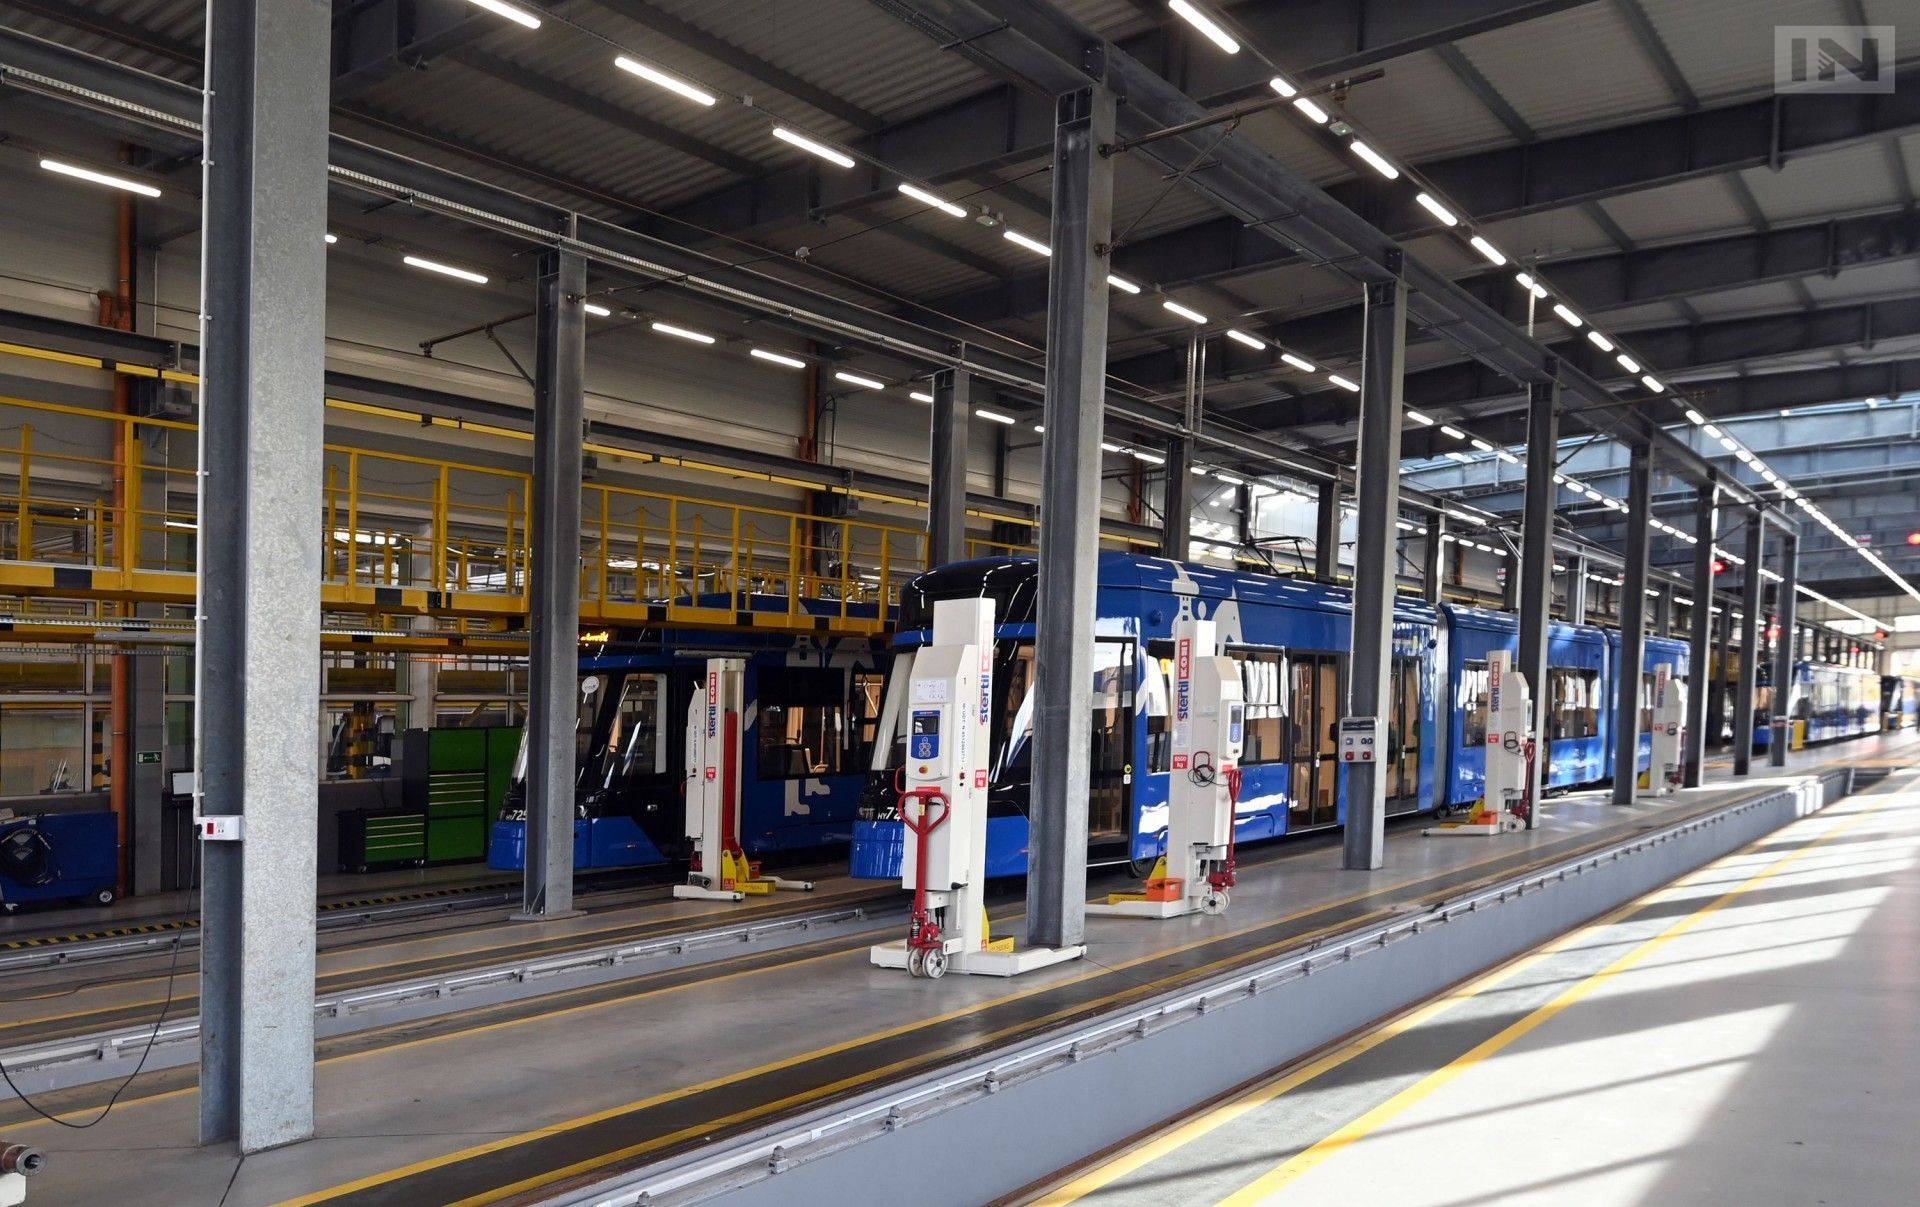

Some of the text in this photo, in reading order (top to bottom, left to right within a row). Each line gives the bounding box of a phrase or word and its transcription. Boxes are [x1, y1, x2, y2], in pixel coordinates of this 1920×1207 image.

[979, 674, 990, 726] stertil
[1177, 681, 1189, 722] stertil
[707, 706, 717, 739] stertil
